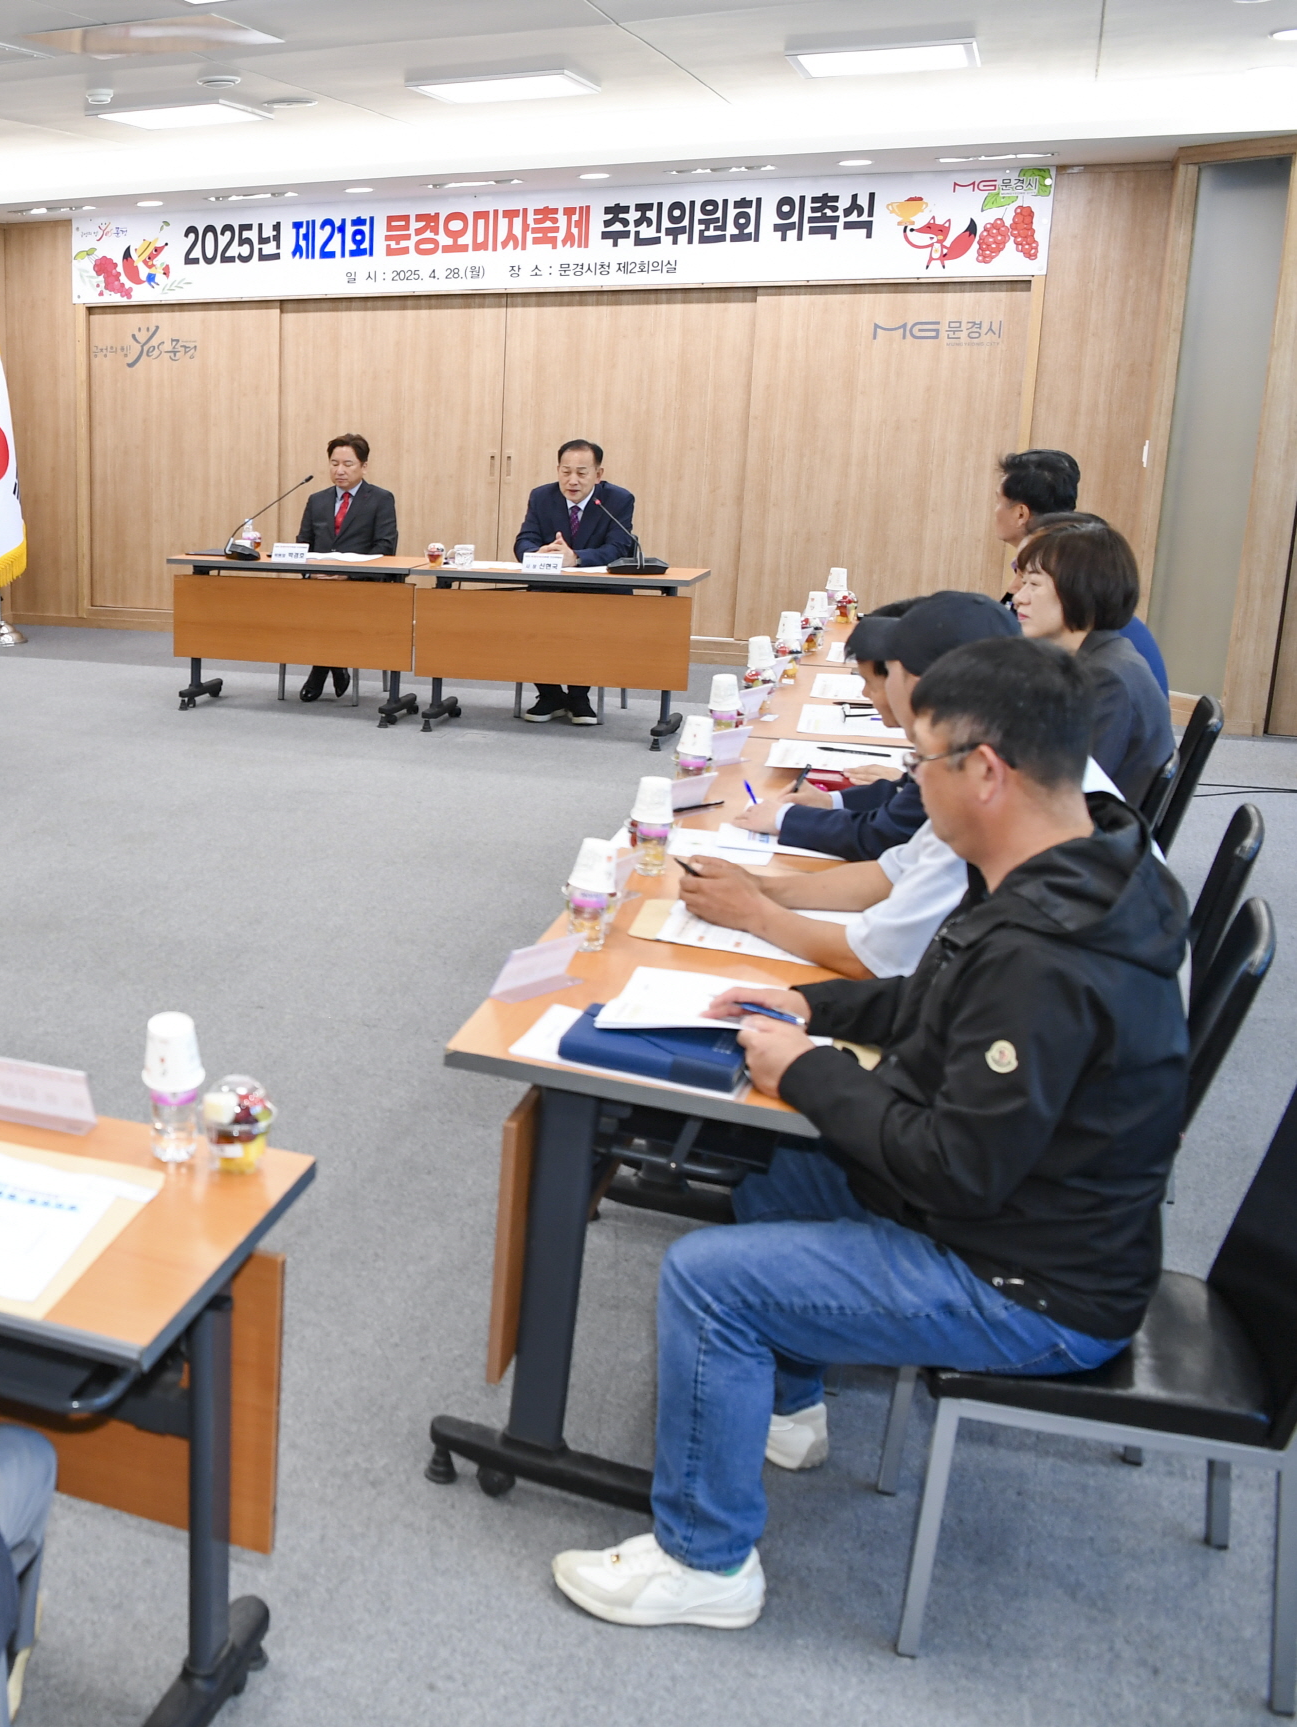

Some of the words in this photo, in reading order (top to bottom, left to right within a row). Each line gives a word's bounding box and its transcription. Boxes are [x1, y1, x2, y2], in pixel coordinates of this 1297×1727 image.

[953, 179, 997, 193] MG
[1000, 177, 1038, 191] 문경시
[183, 220, 282, 265] 2025년
[291, 215, 375, 261] 제21회
[385, 204, 591, 256] 문경오미자축제
[601, 196, 761, 247] 추진위원회
[773, 191, 876, 241] 위촉식
[345, 271, 357, 284] 일
[365, 270, 377, 283] 시
[391, 269, 424, 282] 2025.
[428, 268, 440, 280] 4.
[445, 264, 485, 280] 28.(월)
[508, 264, 521, 278] 장
[529, 264, 543, 277] 소
[558, 261, 610, 277] 문경시청
[615, 259, 678, 275] 제2회의실
[872, 320, 940, 340] MG
[945, 320, 1002, 339] 문경시
[126, 325, 165, 368] Yes
